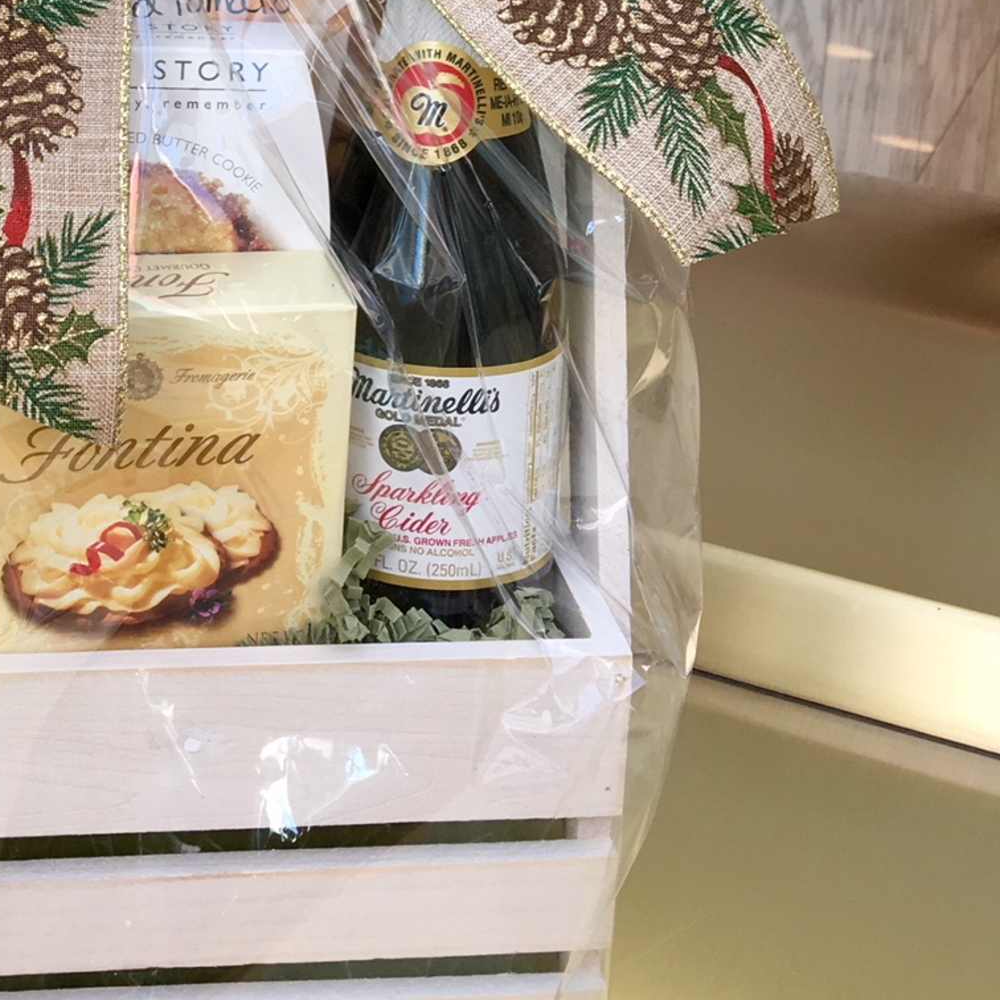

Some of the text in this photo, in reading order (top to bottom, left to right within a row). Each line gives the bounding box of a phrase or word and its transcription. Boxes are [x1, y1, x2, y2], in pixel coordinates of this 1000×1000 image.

[153, 59, 269, 82] STORY
[164, 99, 266, 110] remember
[152, 133, 209, 156] BUTTER
[211, 152, 263, 193] COOKIE
[170, 368, 257, 390] Fromagerie
[352, 470, 484, 513] Sparkling
[371, 501, 452, 535] Cider
[413, 536, 451, 547] GROWN
